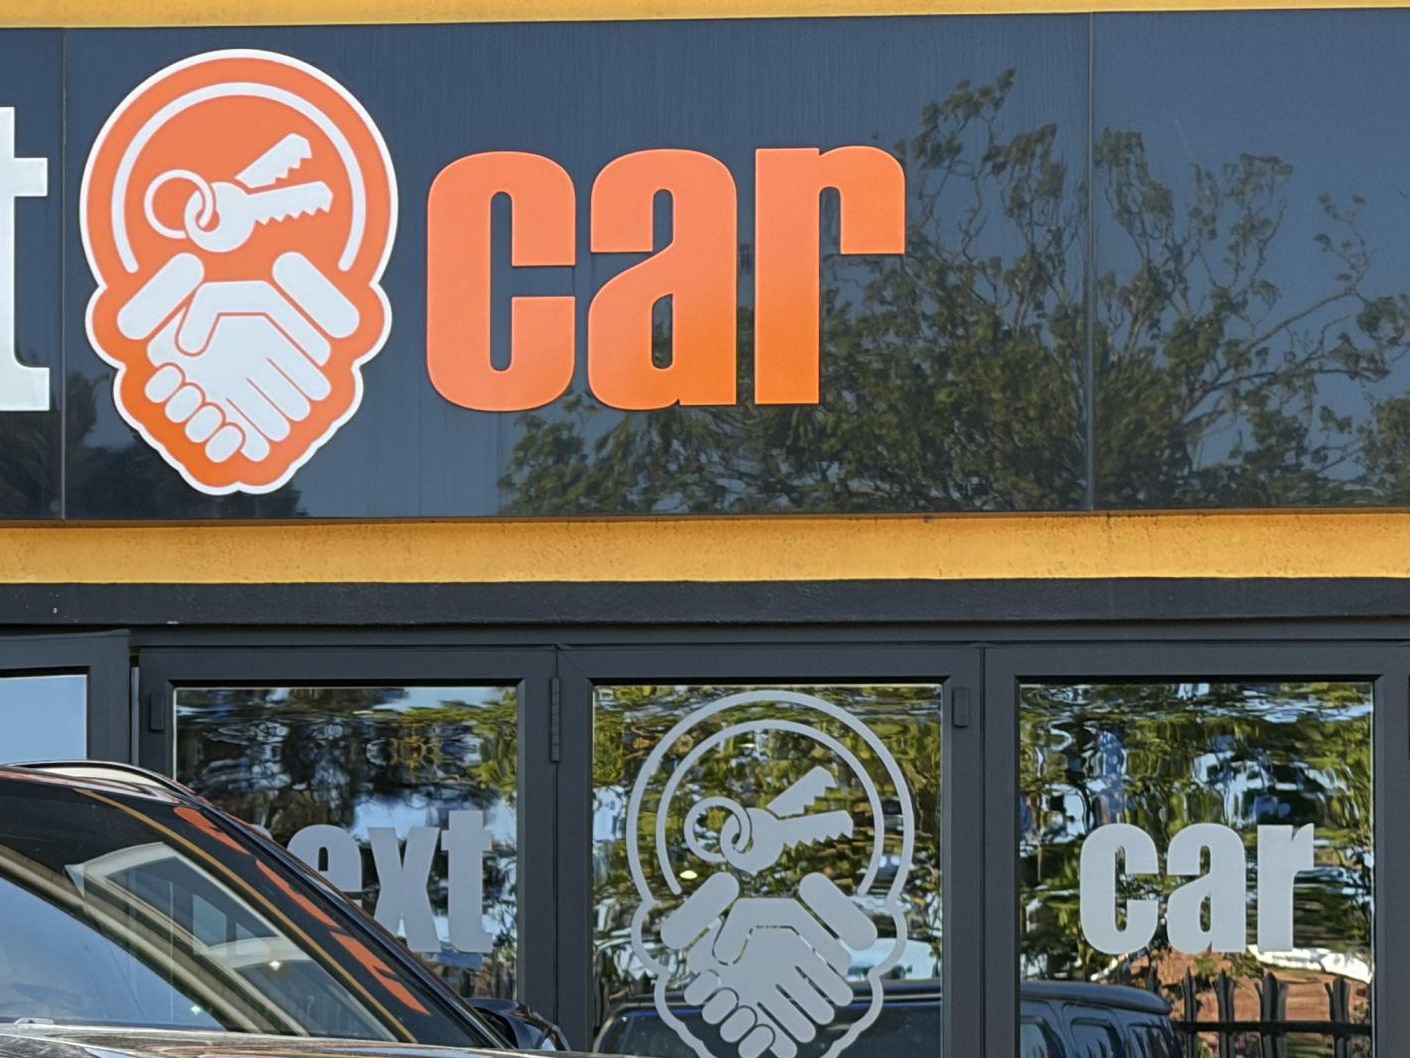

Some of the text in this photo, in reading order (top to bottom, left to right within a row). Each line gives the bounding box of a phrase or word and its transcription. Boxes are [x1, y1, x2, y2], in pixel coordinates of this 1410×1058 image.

[426, 145, 907, 412] car
[251, 809, 1316, 955] ext car
